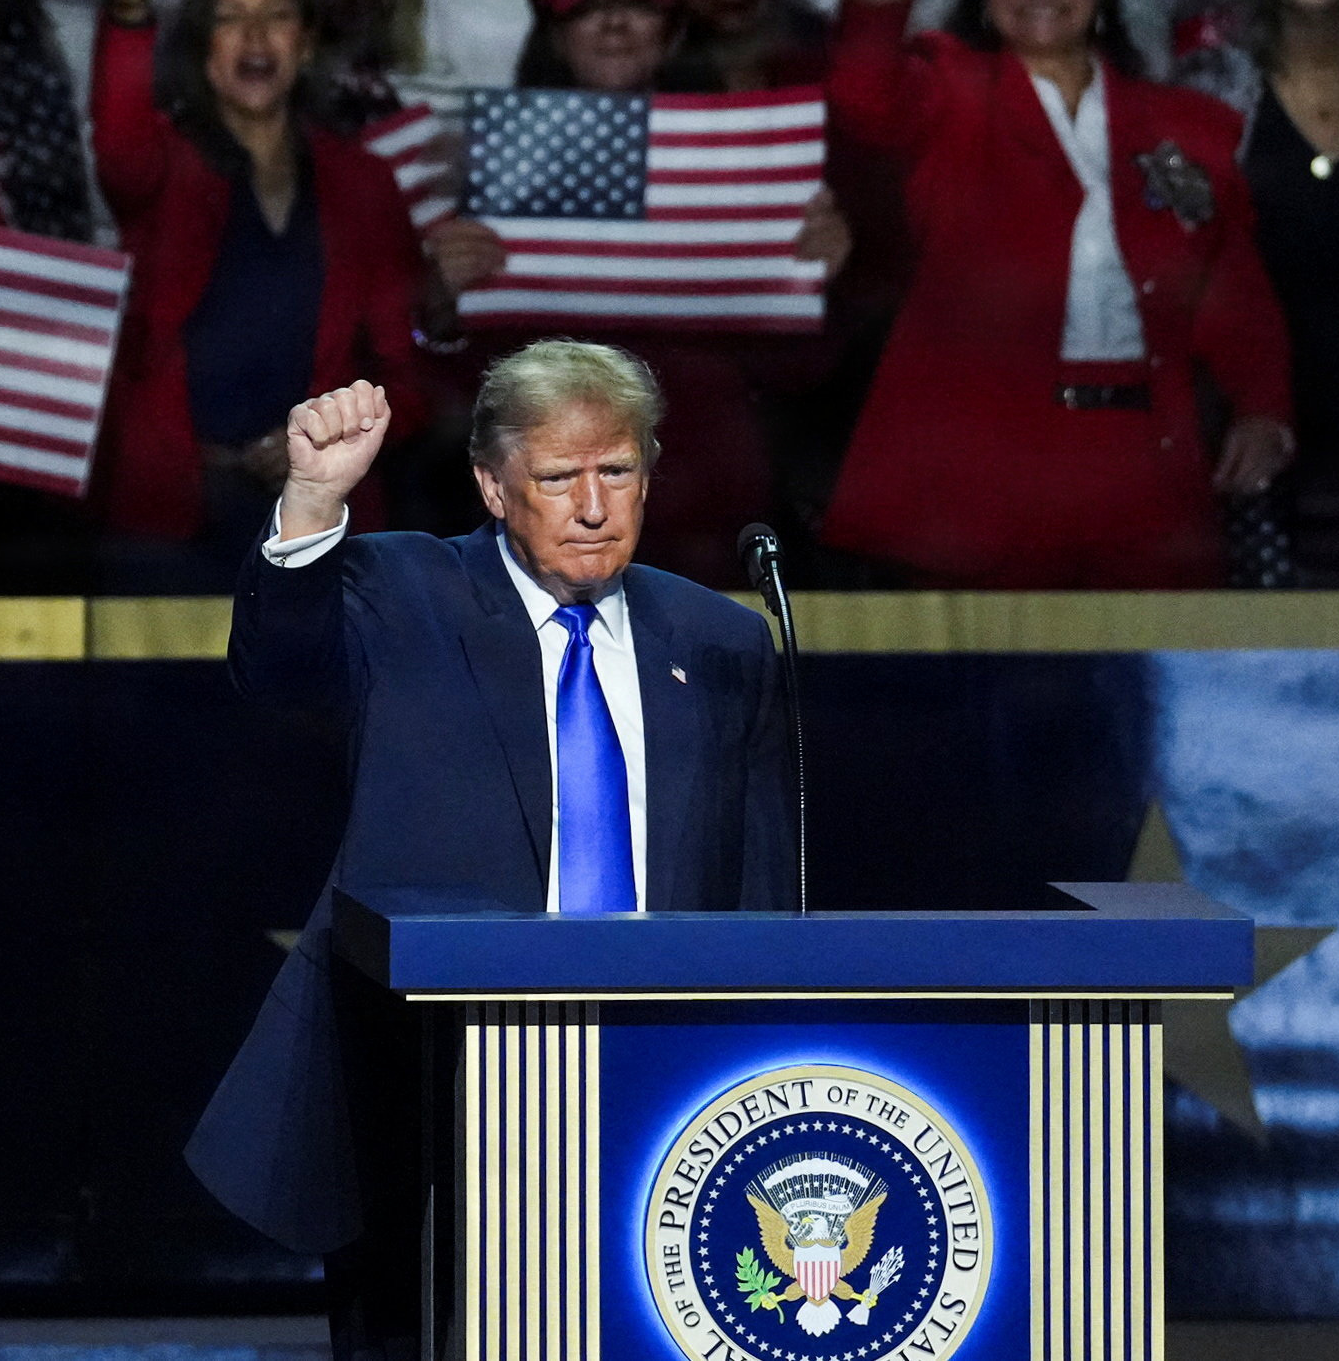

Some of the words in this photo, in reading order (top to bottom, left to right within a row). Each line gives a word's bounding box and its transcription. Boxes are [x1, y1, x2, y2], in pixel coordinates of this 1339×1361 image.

[827, 1086, 859, 1105] OF
[866, 1094, 910, 1129] THE
[659, 1080, 813, 1232] PRESIDENT
[791, 1200, 827, 1210] PLURIBUS
[828, 1203, 850, 1211] UNUM
[914, 1125, 979, 1272] UNITED
[662, 1243, 686, 1294] THE
[675, 1299, 701, 1328] OF
